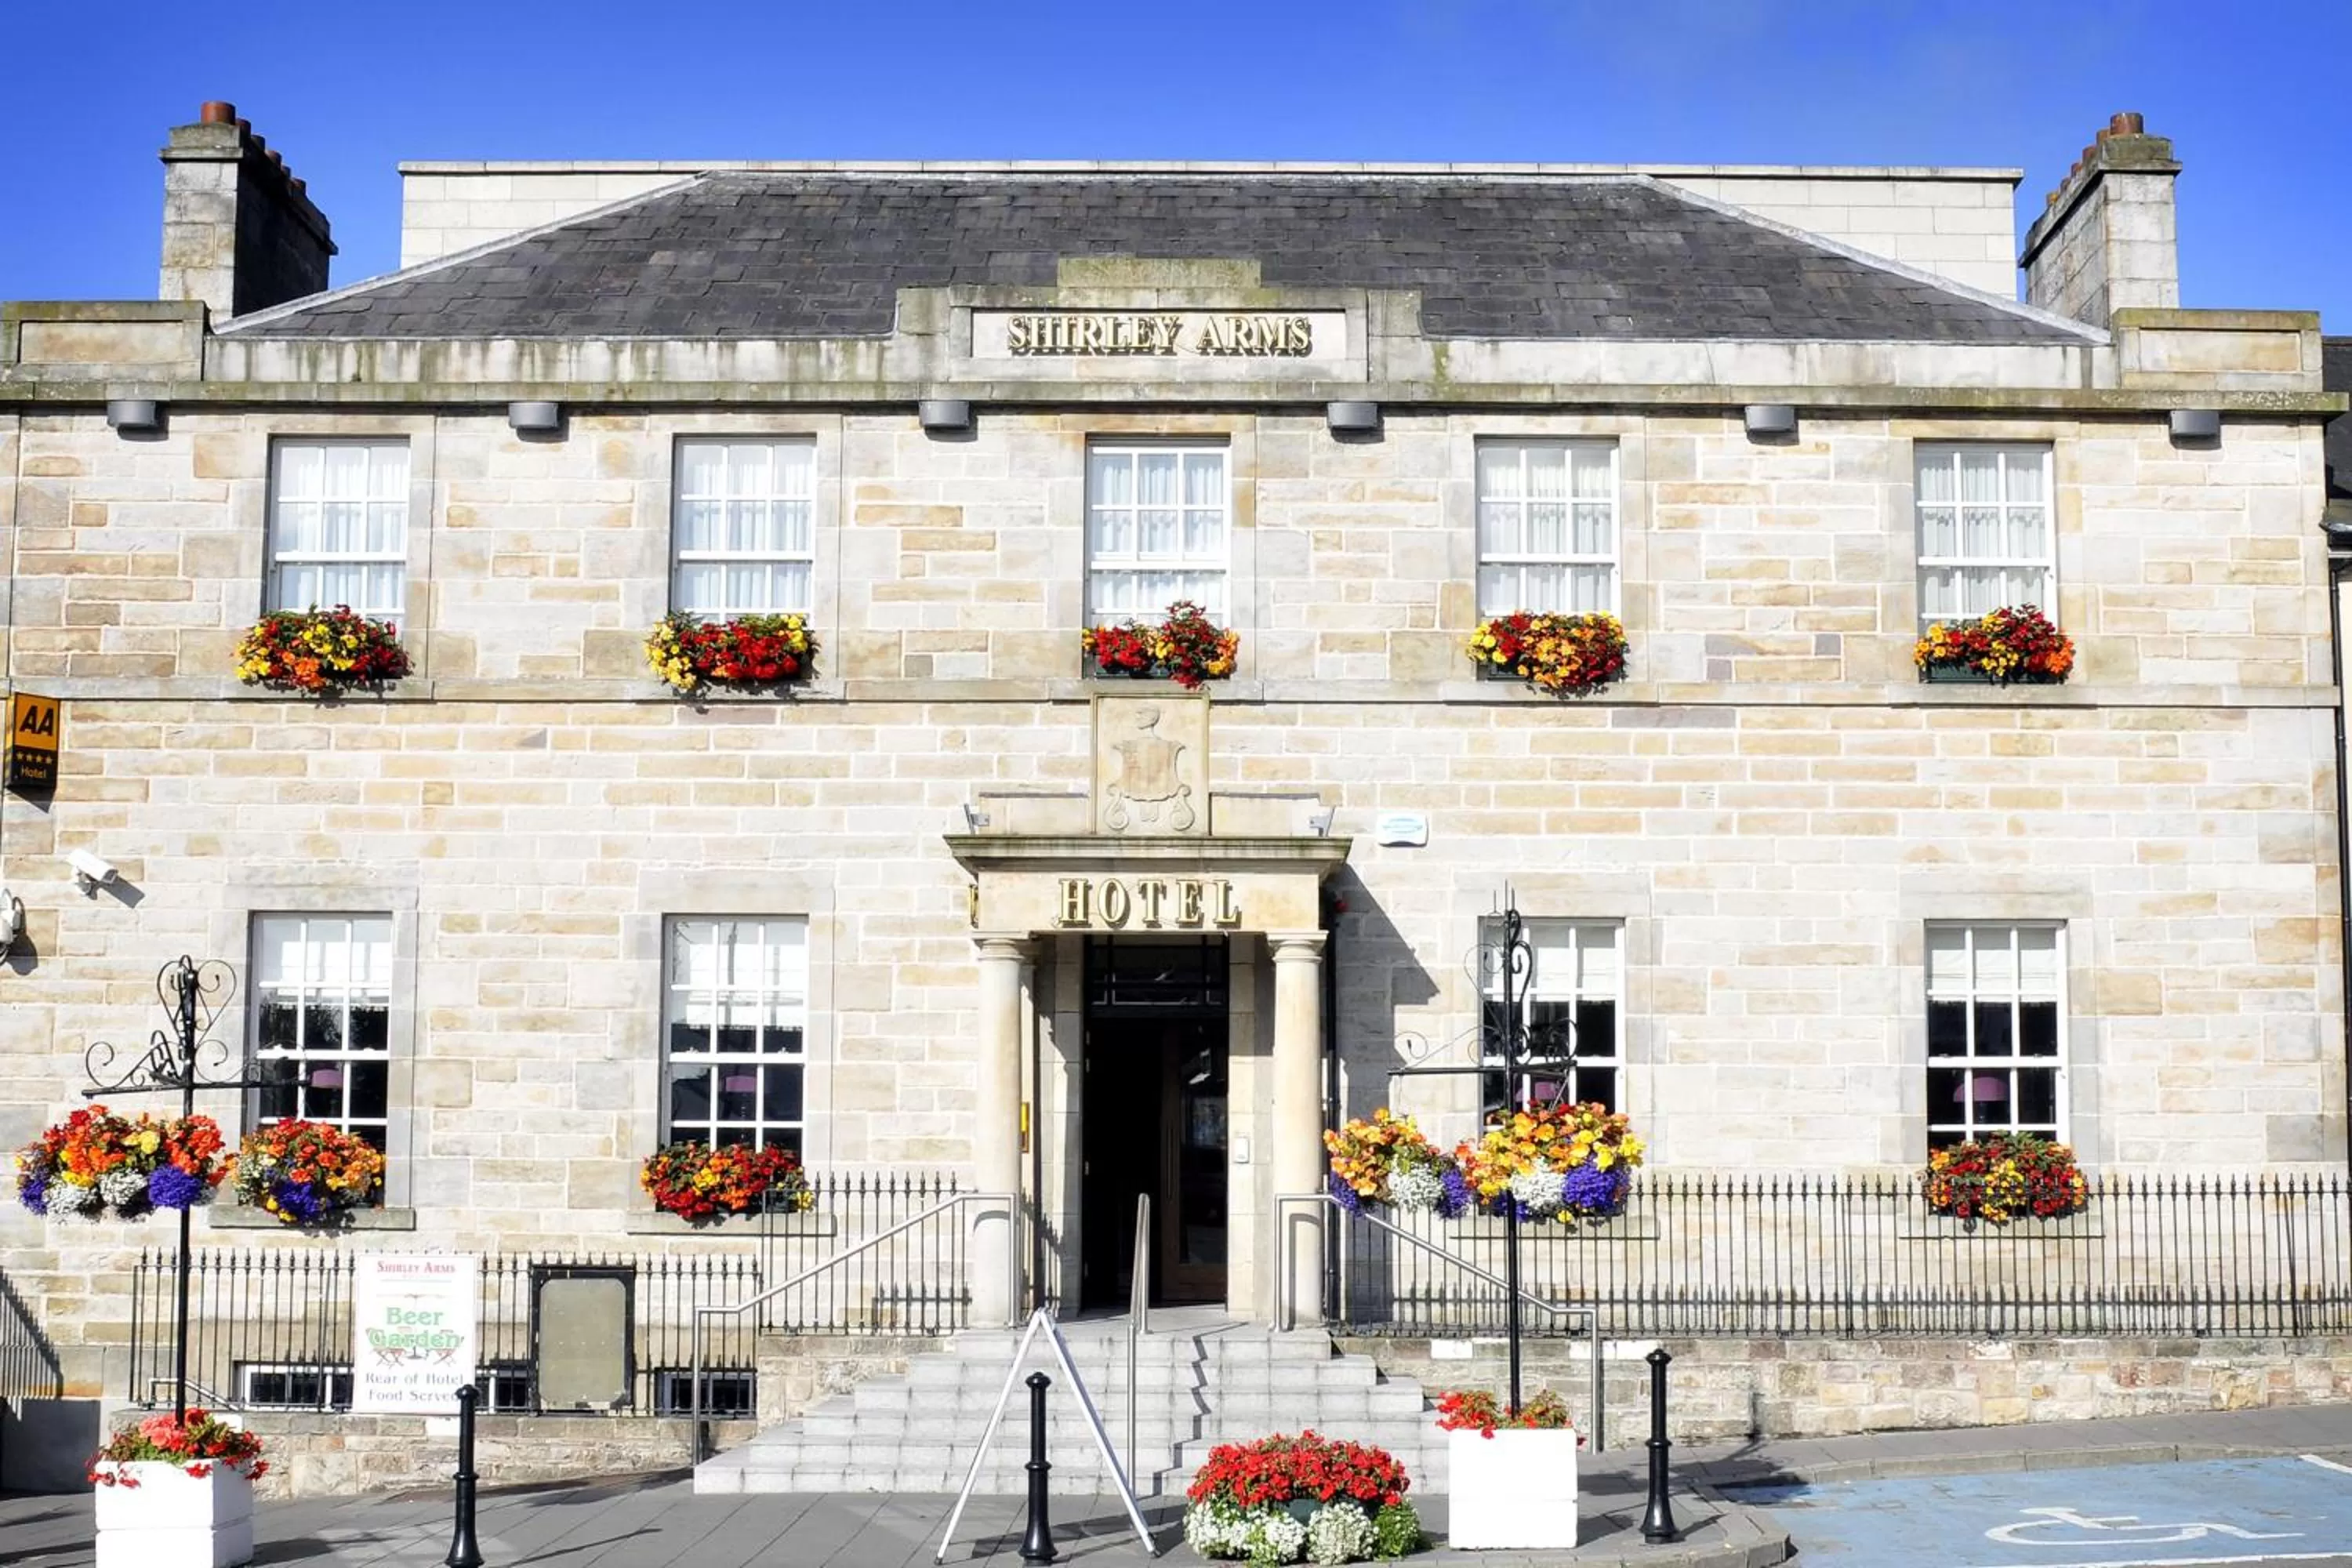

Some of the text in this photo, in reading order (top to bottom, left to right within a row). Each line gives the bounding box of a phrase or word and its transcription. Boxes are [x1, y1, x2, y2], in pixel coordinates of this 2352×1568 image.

[1007, 314, 1312, 356] SHIRLEY ARMS
[19, 705, 54, 737] AA
[21, 765, 47, 779] Hotel
[1058, 878, 1241, 928] HOTEL
[424, 1261, 456, 1273] ARMS
[386, 1307, 444, 1325] Beer
[368, 1330, 461, 1348] Garden
[365, 1372, 463, 1385] Rear of Hotel
[368, 1390, 403, 1402] Food
